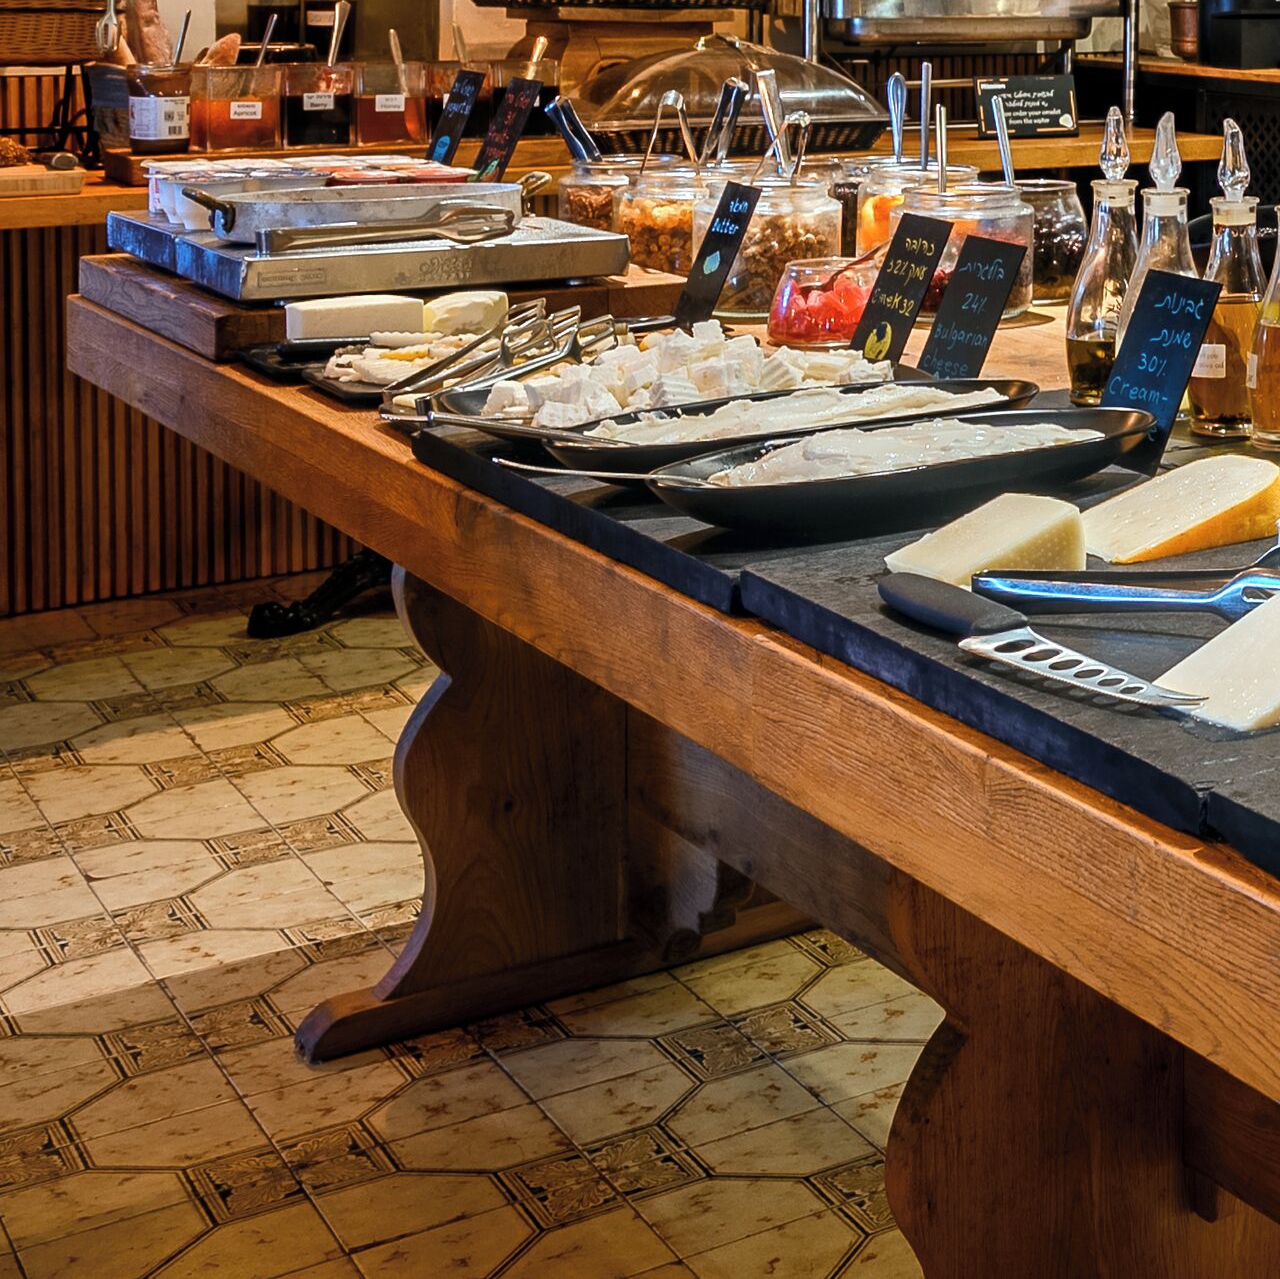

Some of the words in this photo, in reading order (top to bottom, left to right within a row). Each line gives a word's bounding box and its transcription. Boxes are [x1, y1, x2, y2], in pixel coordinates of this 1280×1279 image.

[886, 259, 907, 279] 32%
[904, 262, 928, 286] עמק
[958, 259, 1006, 282] בולגרית
[899, 299, 915, 317] 32
[961, 292, 989, 314] 24%
[1154, 292, 1205, 320] גבינות
[933, 321, 989, 350] Bulgarian
[1149, 328, 1193, 349] שמנת
[1137, 352, 1168, 377] 30%
